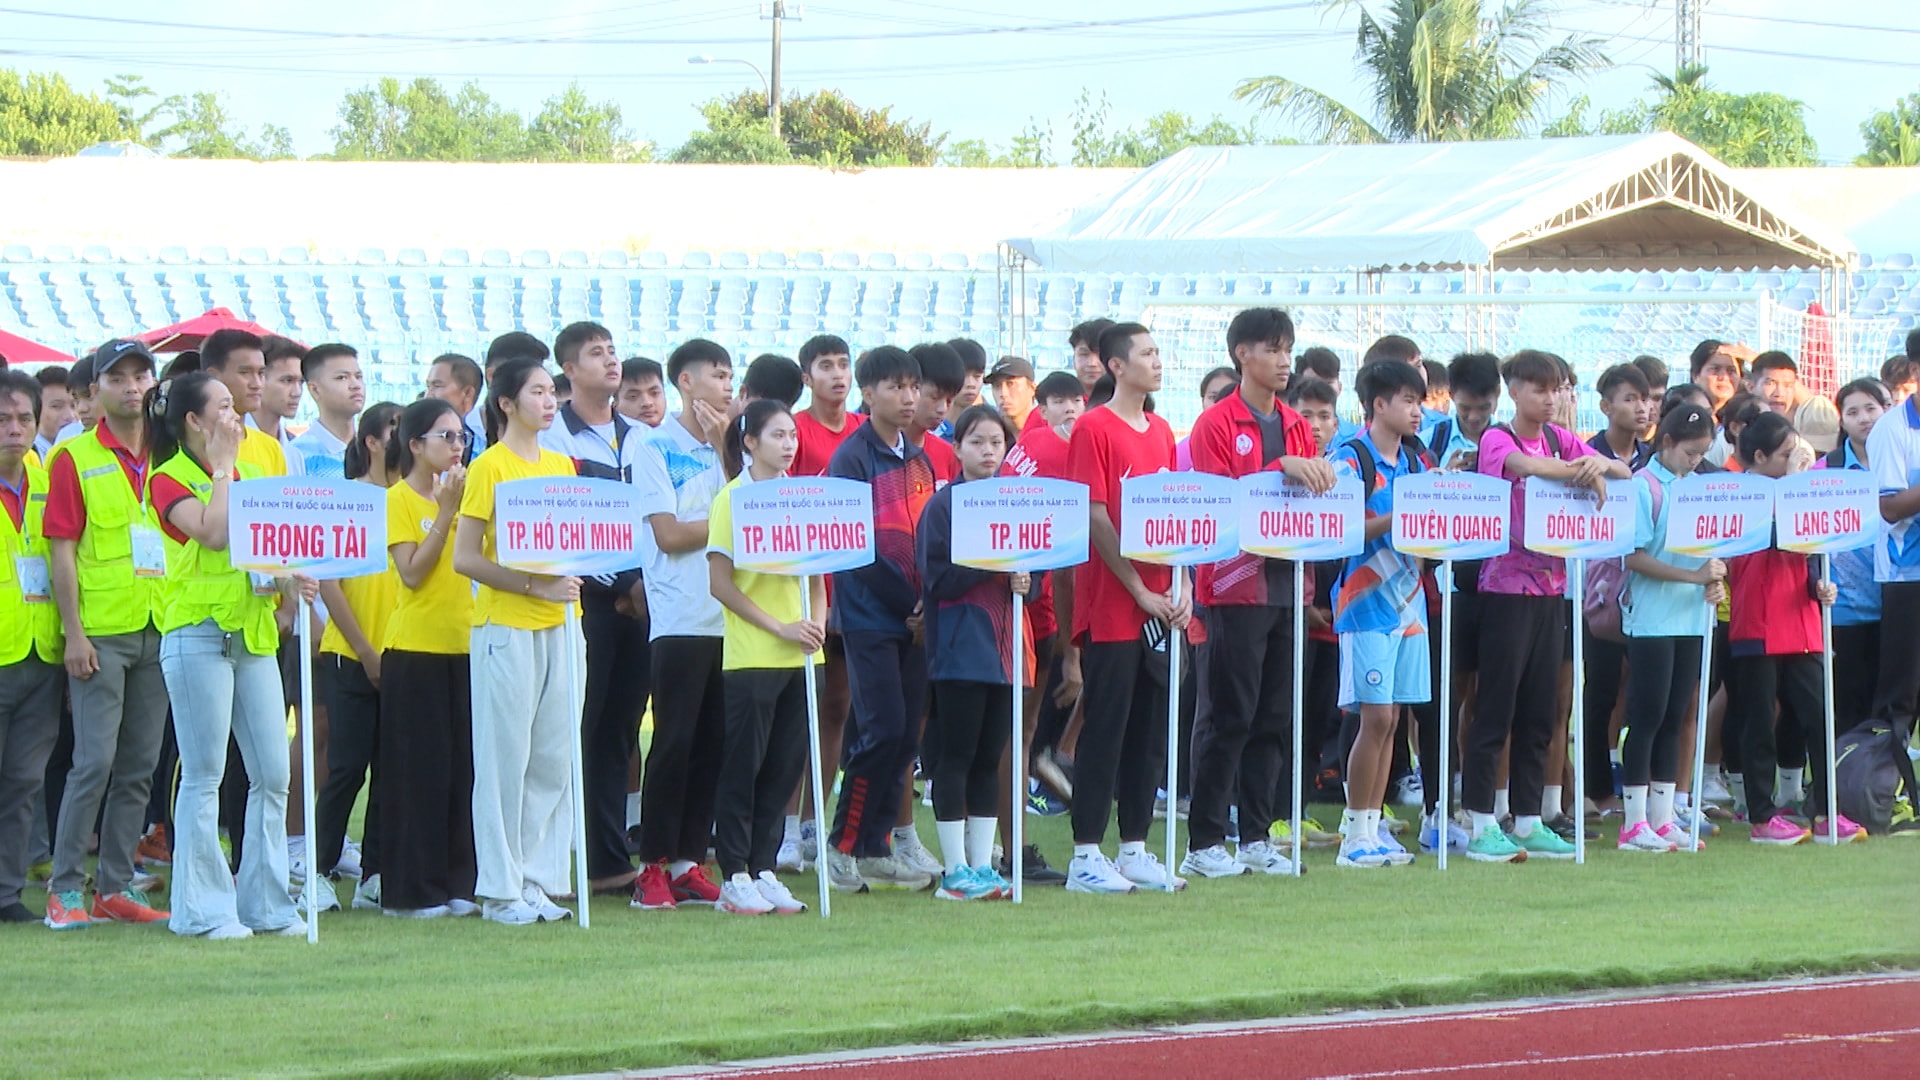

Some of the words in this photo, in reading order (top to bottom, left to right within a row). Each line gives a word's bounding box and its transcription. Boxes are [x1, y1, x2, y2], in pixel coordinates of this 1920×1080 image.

[282, 487, 299, 496] GIẢI
[302, 487, 312, 496] VÔ
[315, 488, 334, 497] ĐỊCH
[296, 500, 318, 510] QUỐC
[337, 501, 354, 512] NĂM
[356, 504, 374, 512] 2025
[507, 521, 528, 550] TP.
[534, 512, 554, 550] HỒ
[560, 516, 585, 550] CHÍ
[591, 523, 633, 551] MINH
[742, 526, 766, 554] TP.
[772, 515, 801, 552] HẢI
[806, 515, 866, 551] PHÒNG
[990, 523, 1012, 550] TP.
[1019, 513, 1053, 550] HUẾ
[1145, 514, 1186, 548] QUÂN
[1192, 514, 1217, 551] ĐỘI
[1260, 502, 1314, 539] QUẢNG
[1320, 513, 1343, 544] TRỊ
[1401, 509, 1447, 539] TUYÊN
[1453, 515, 1502, 543] QUANG
[1547, 506, 1585, 540] ĐỒNG
[1590, 517, 1614, 541] NAI
[1696, 515, 1718, 539] GIA
[1722, 514, 1743, 538] LAI
[1794, 511, 1829, 541] LẠNG
[1834, 506, 1860, 534] SƠN
[250, 523, 324, 564] TRỌNG
[332, 519, 366, 558] TÀI
